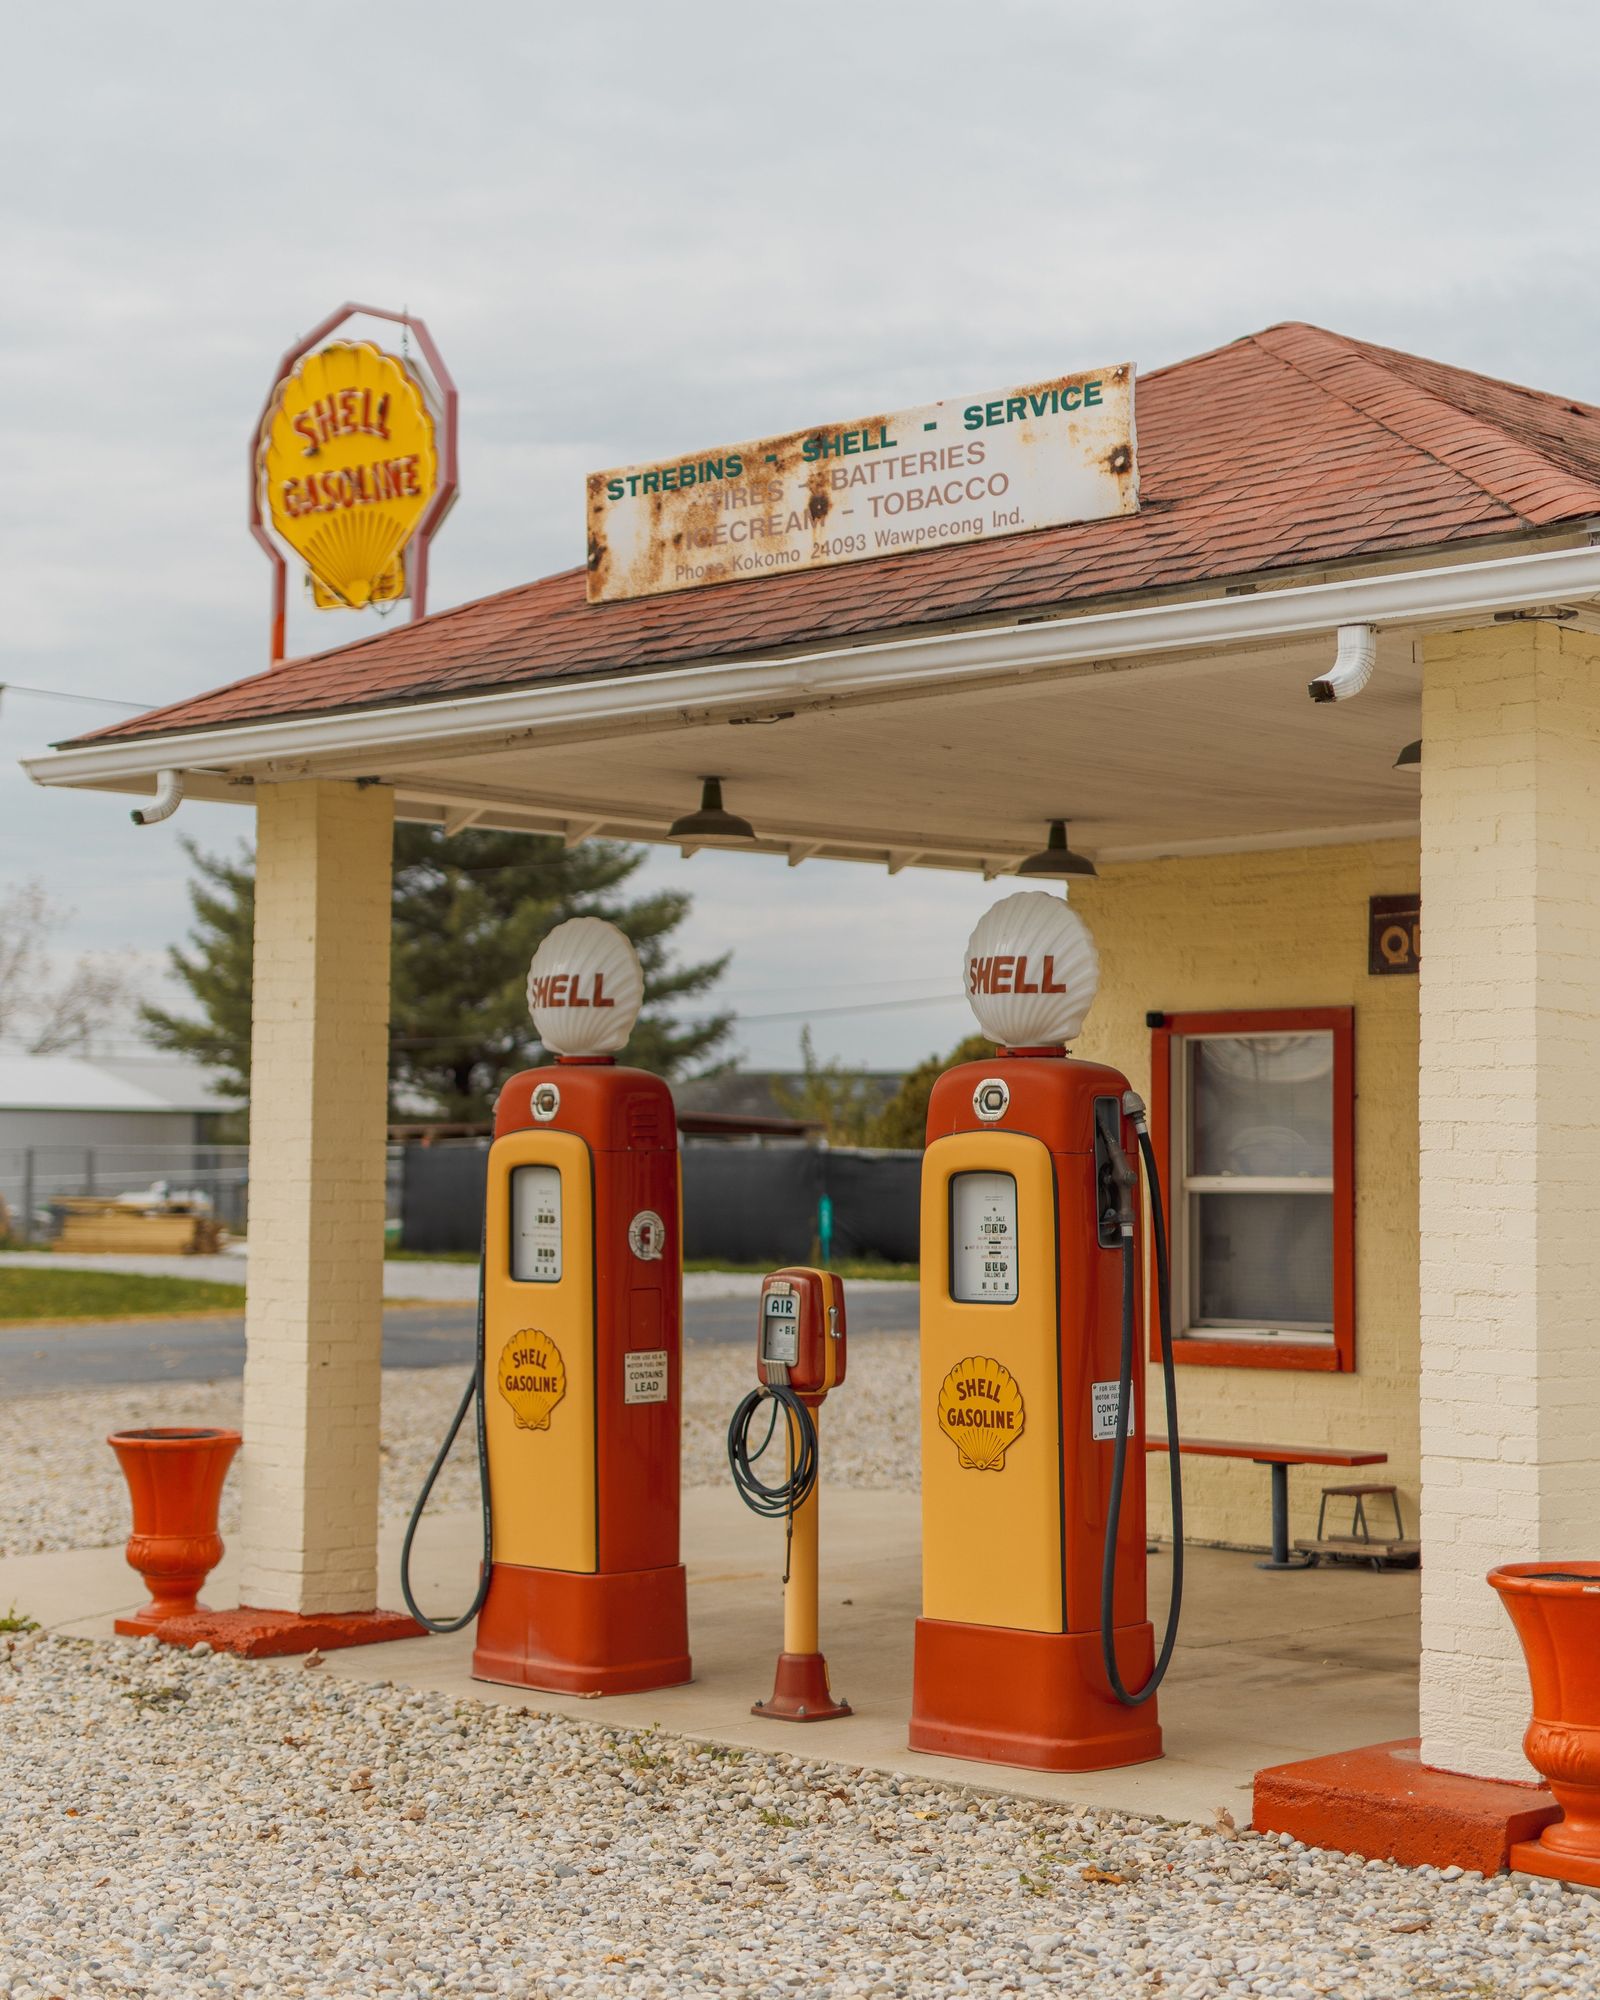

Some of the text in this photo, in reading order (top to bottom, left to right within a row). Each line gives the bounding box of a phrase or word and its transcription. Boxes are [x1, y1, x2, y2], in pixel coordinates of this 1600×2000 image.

[293, 386, 391, 458] SHELL
[607, 454, 744, 501] STREBINS
[802, 425, 898, 463] SHELL
[963, 381, 1104, 431] SERVICE
[282, 453, 422, 519] GASOLINE
[707, 479, 784, 512] TIRES
[831, 441, 986, 491] BATTERIES
[867, 472, 1009, 518] TOBACCO
[732, 548, 801, 573] Kokomo
[810, 533, 867, 560] 24093
[875, 515, 984, 548] Wawpecong
[992, 506, 1025, 528] Ind.
[970, 955, 1067, 995] SHELL
[532, 973, 615, 1009] SHELL
[771, 1300, 793, 1314] AIR
[512, 1348, 547, 1370] SHELL
[505, 1375, 558, 1393] GASOLINE
[629, 1370, 664, 1380] CONTAINS
[635, 1381, 659, 1393] LEAD
[956, 1378, 1002, 1403] SHELL
[947, 1407, 1015, 1429] GASOLINE
[1097, 1403, 1120, 1413] CONTA
[1103, 1415, 1119, 1427] LEA
